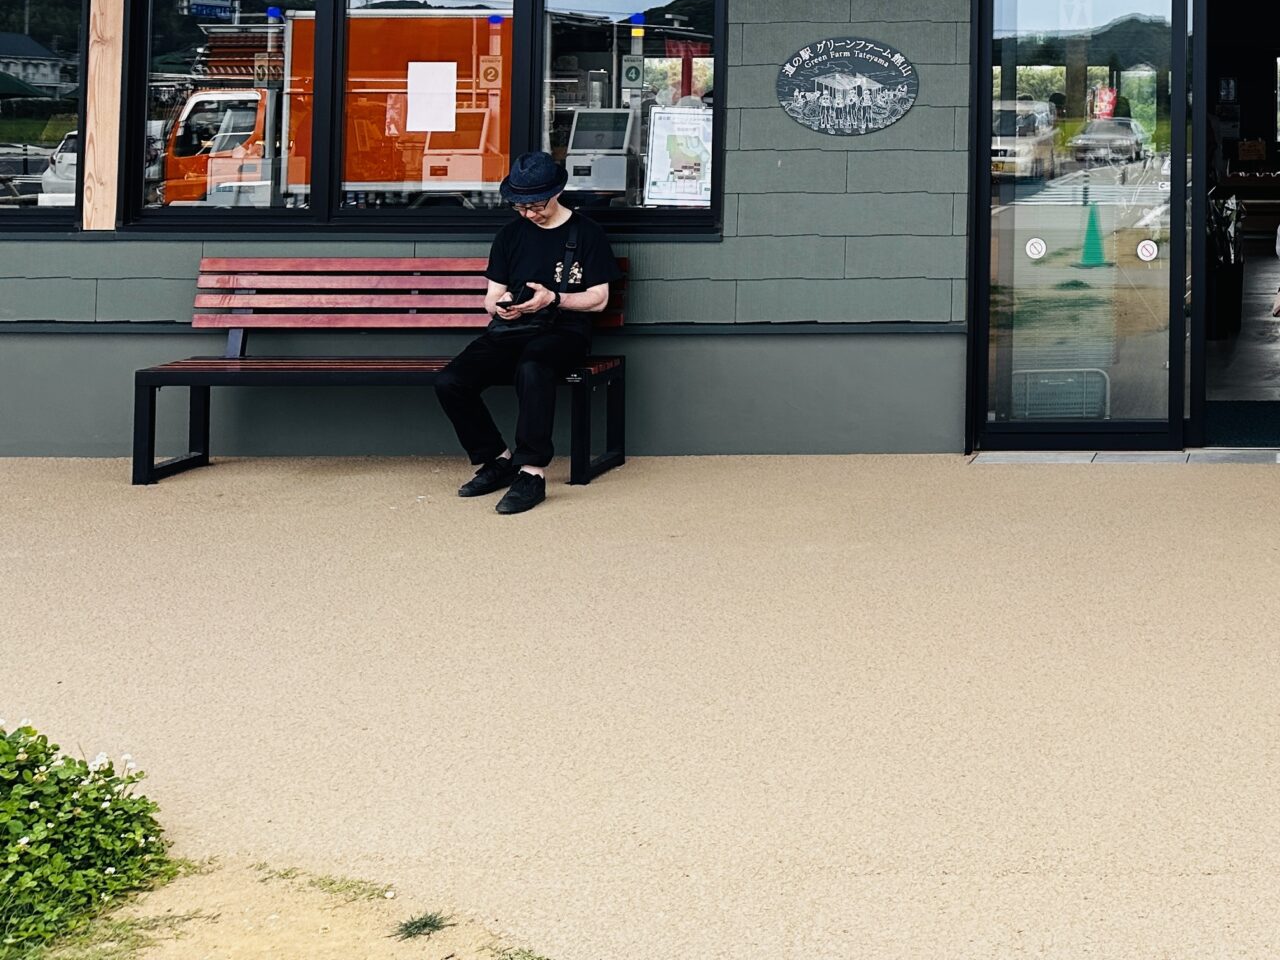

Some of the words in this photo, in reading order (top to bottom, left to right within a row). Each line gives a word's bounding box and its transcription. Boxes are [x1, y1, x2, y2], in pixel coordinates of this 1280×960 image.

[782, 46, 815, 78] 道の駅
[804, 54, 828, 68] Green
[829, 50, 851, 59] Farm
[853, 50, 889, 68] Tateyama
